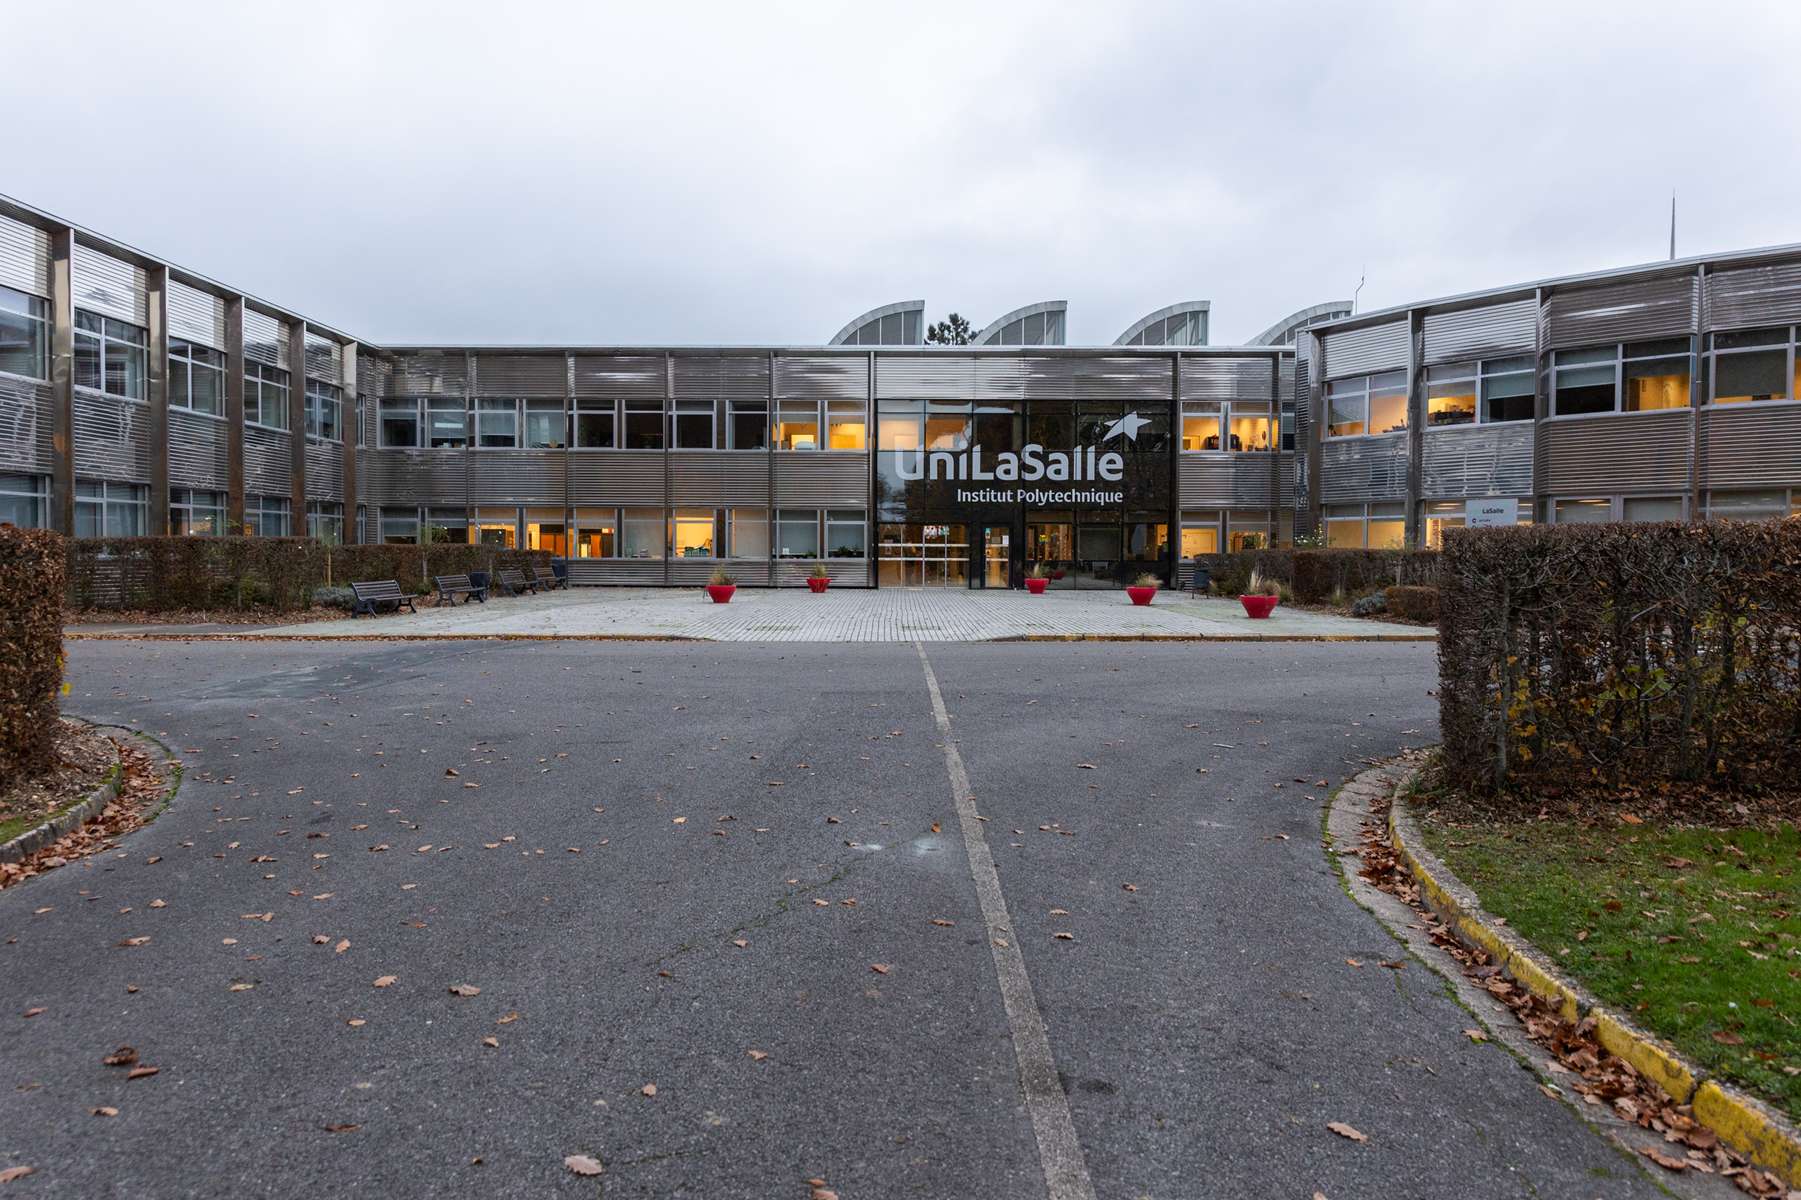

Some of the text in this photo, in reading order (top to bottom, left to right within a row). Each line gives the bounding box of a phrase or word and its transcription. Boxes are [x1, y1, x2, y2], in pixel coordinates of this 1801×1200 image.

[895, 441, 1123, 481] UniLaSalle
[957, 488, 1123, 506] Institut Polytechnique
